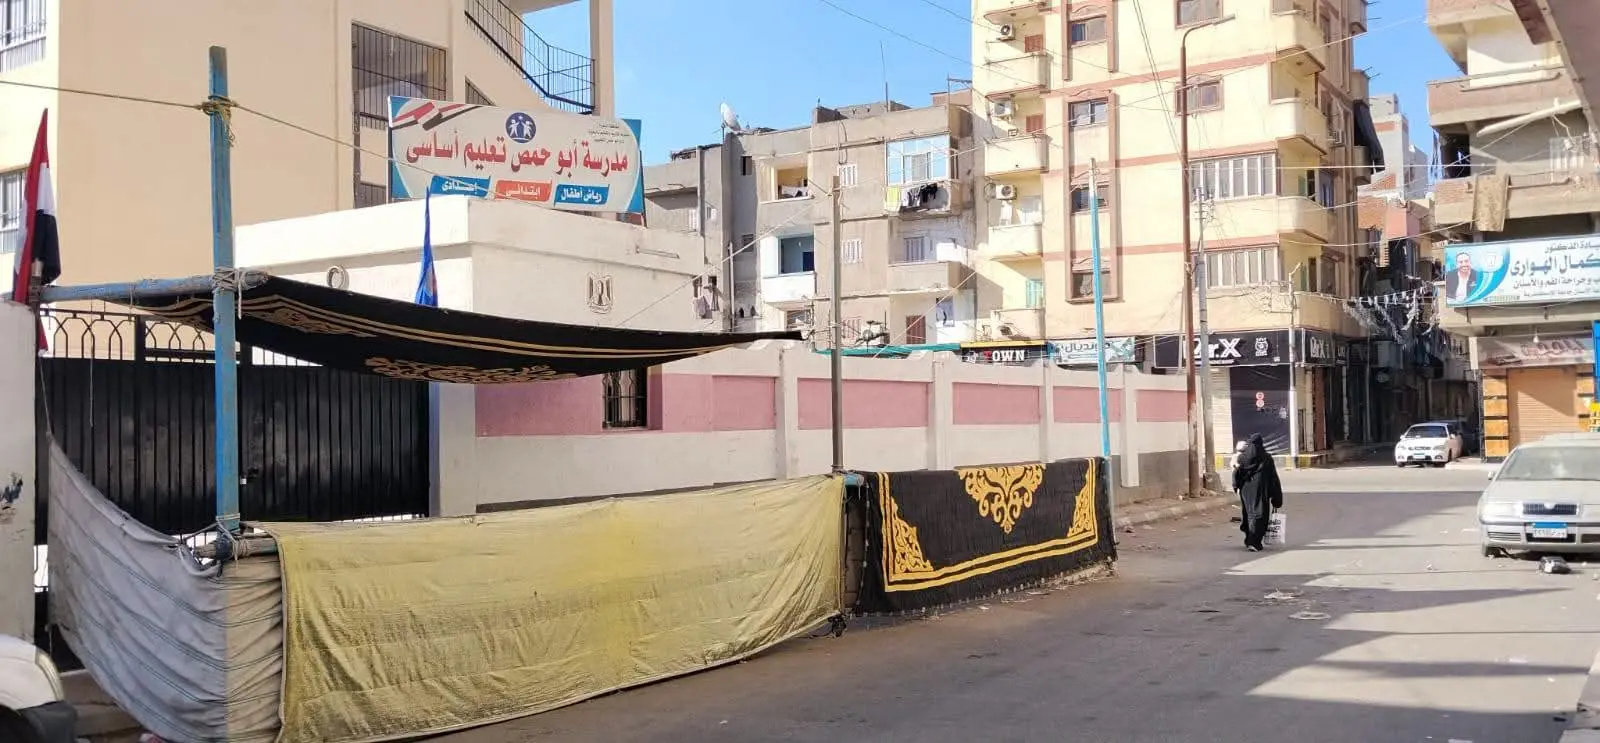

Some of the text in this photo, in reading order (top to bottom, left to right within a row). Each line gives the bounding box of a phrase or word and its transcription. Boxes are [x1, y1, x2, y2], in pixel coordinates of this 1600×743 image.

[463, 135, 507, 170] تعليم
[510, 144, 551, 172] حمص
[556, 138, 578, 178] أبو
[582, 140, 629, 177] مدرسة
